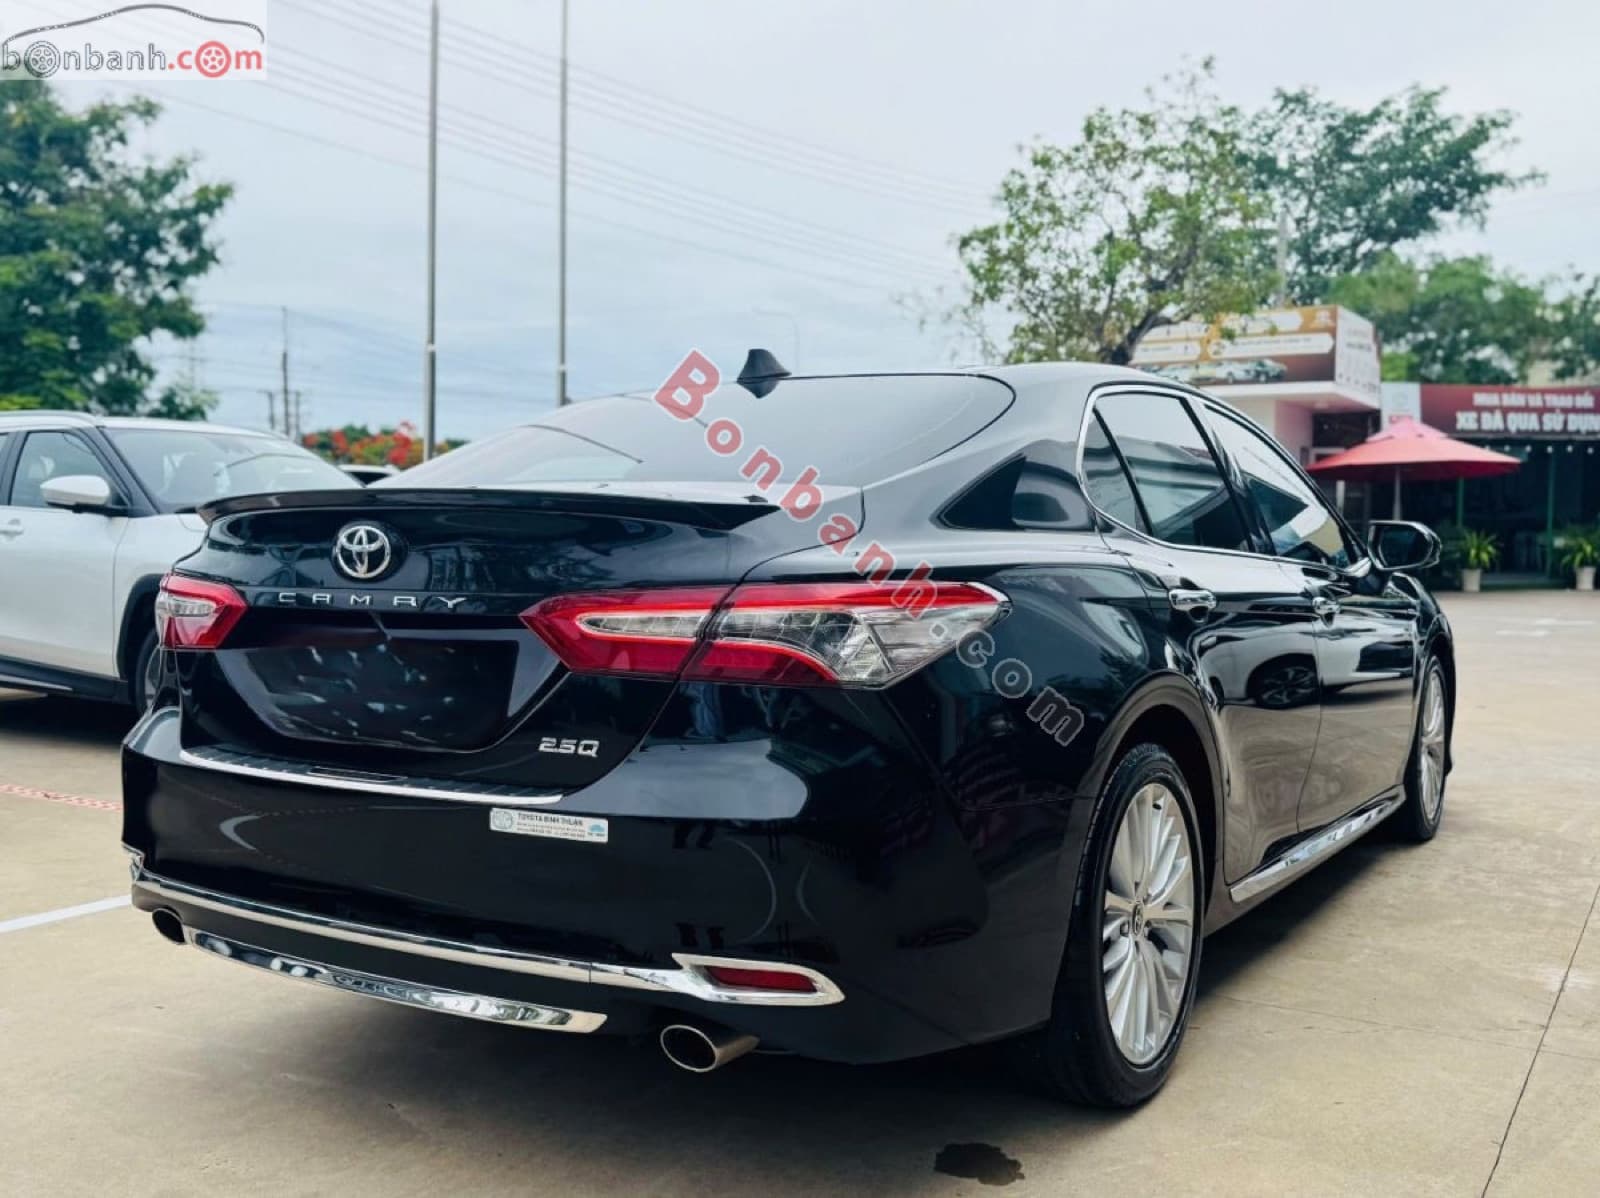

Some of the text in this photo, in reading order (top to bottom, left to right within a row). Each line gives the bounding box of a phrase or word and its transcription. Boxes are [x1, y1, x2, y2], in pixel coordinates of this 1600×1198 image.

[1456, 411, 1478, 430] XE
[1507, 412, 1539, 433] QUA
[278, 592, 467, 609] CAMRY
